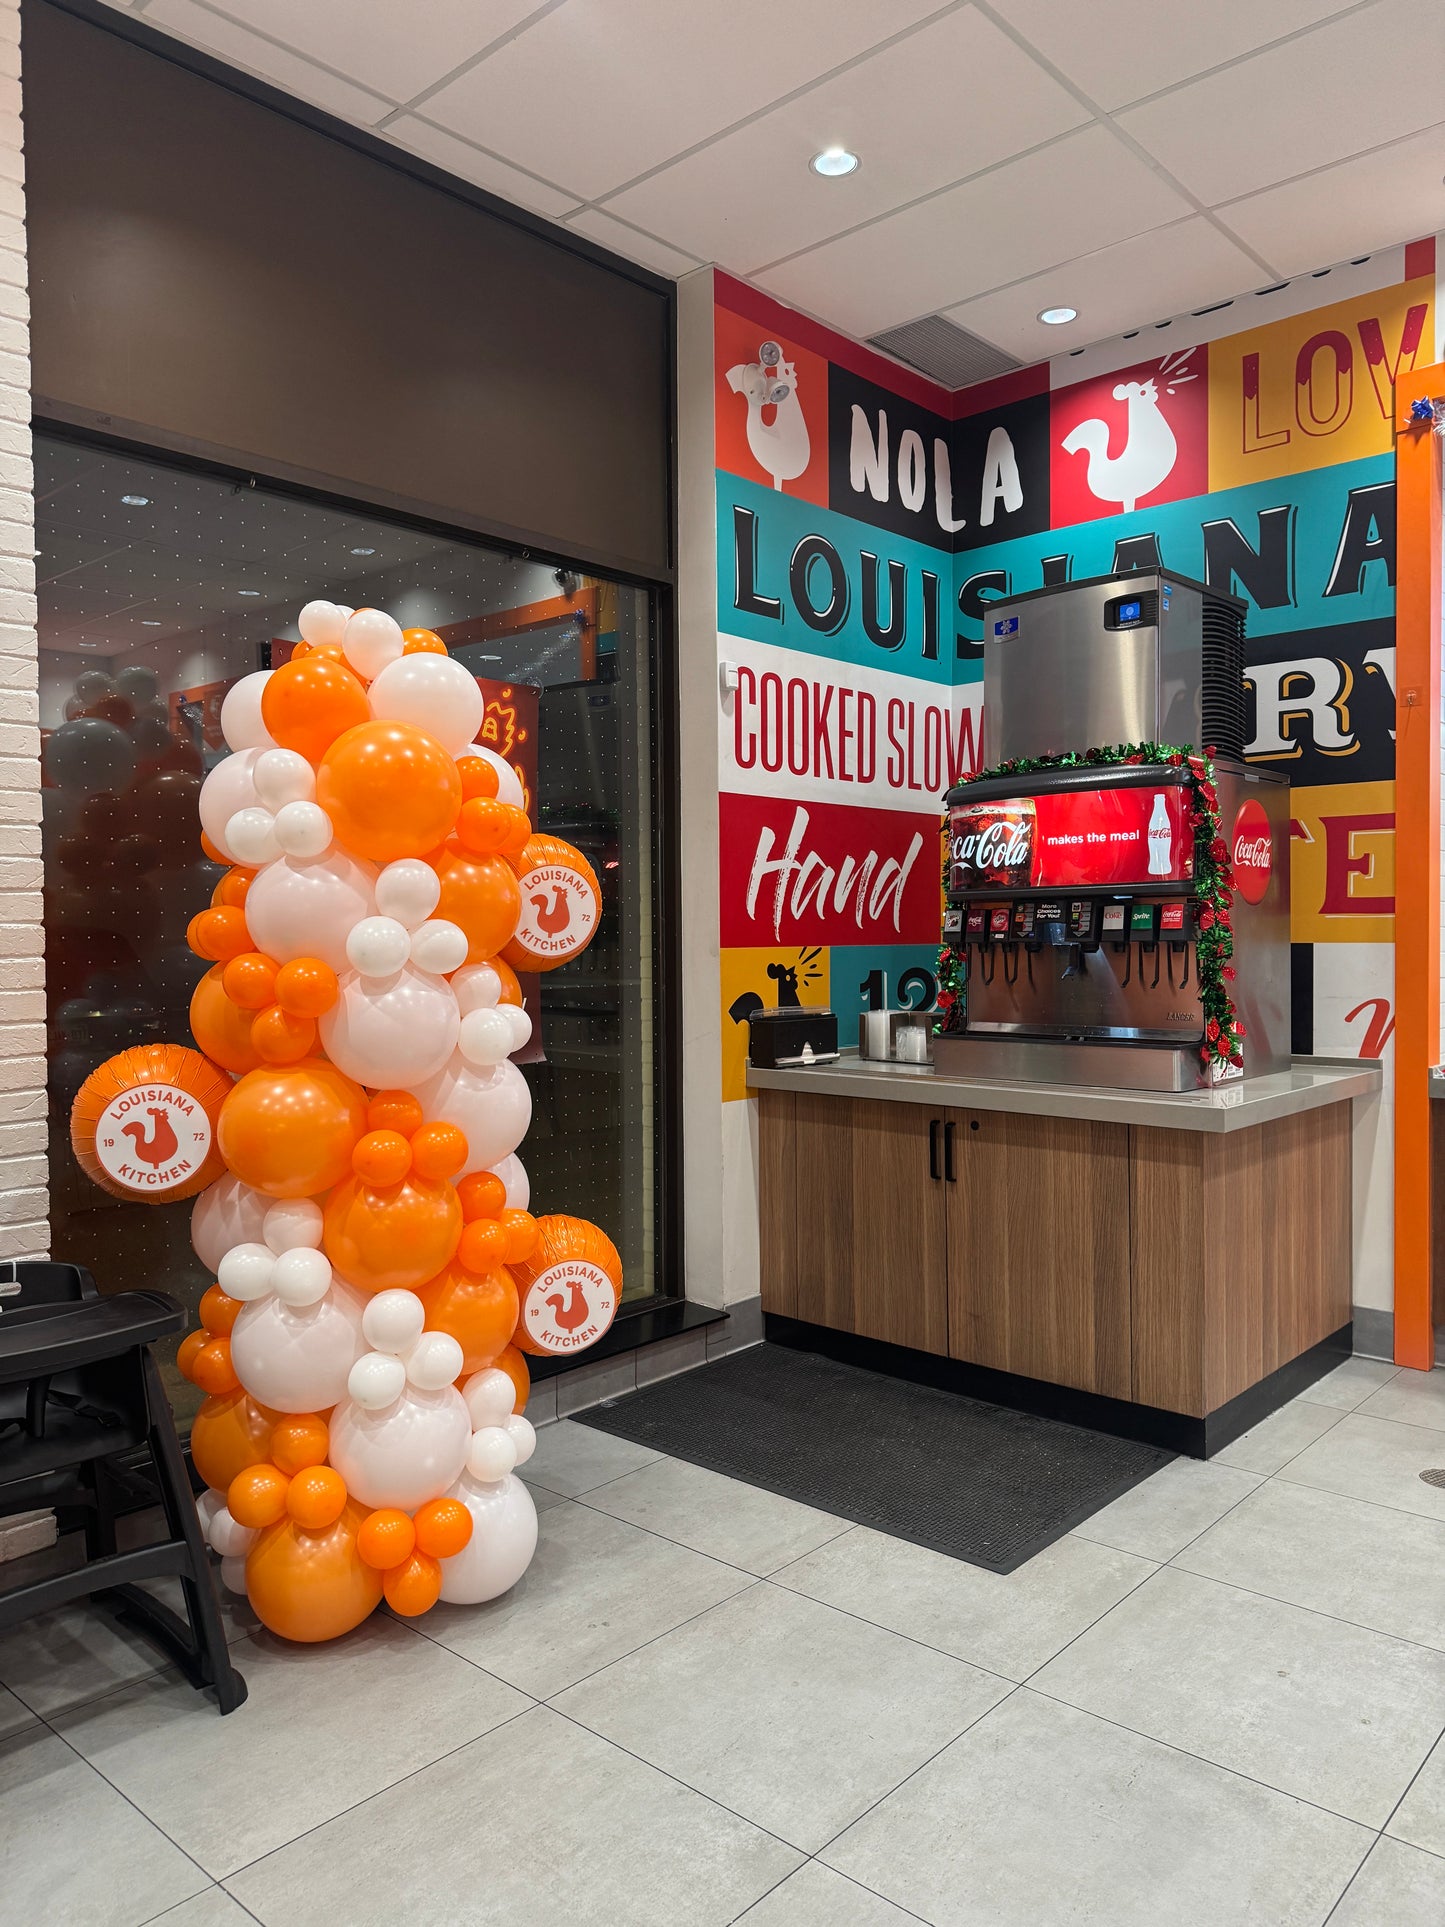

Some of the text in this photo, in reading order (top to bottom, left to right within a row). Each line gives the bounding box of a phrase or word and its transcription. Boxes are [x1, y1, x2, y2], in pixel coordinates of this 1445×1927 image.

[850, 404, 1023, 533] NOLA
[733, 480, 1397, 662] LOUISNA
[734, 666, 984, 793] COOKED SLOW
[1047, 830, 1140, 846] makes the meal
[1234, 835, 1272, 868] Coca-Cola
[524, 870, 588, 899] LOUISIANA
[746, 806, 923, 943] Hand
[520, 928, 576, 951] KITCHEN
[110, 1090, 195, 1120] LOUISIANA
[103, 1132, 205, 1147] 19 72
[118, 1159, 192, 1184] KITCHEN
[537, 1266, 604, 1293] LOUISIANA
[530, 1301, 610, 1317] 19 72
[540, 1325, 598, 1347] KITCHEN
